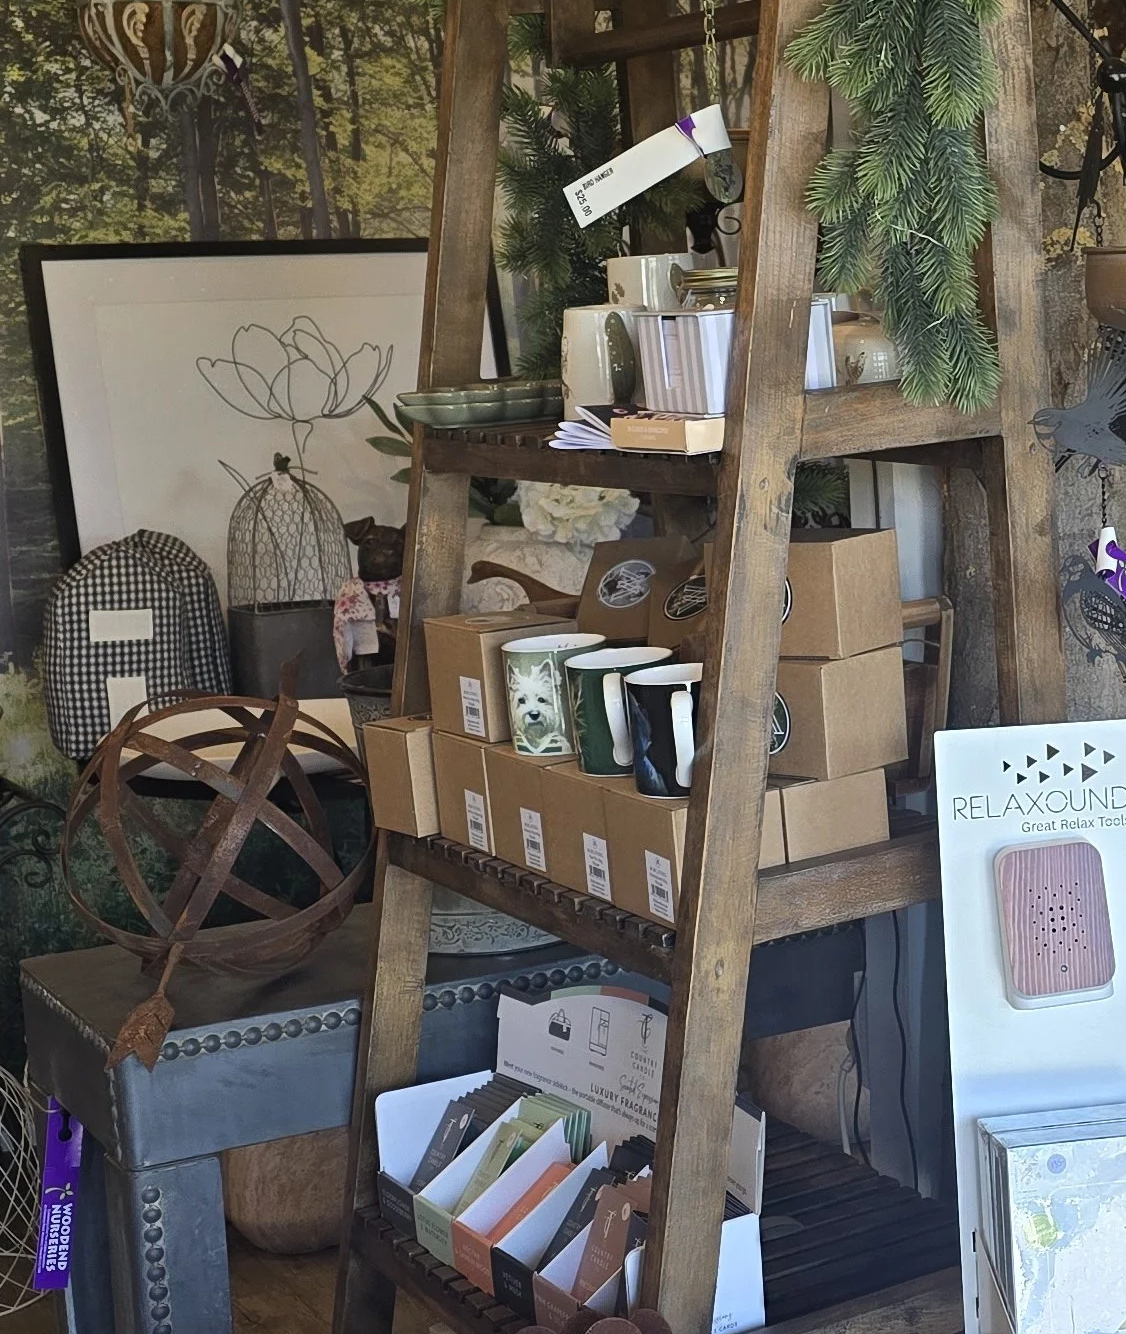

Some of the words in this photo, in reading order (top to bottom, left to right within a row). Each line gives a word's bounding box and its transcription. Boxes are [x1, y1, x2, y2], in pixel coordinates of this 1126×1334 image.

[575, 189, 593, 217] $25.00
[1021, 821, 1057, 833] Great
[1061, 819, 1095, 830] Relax
[630, 1050, 658, 1068] COUNTRY
[632, 1061, 655, 1078] CANDLE
[590, 1082, 618, 1102] LUXURY
[620, 1096, 658, 1123] FRAGRANC
[45, 1204, 62, 1272] NURSERIES
[57, 1202, 73, 1271] WOODEND
